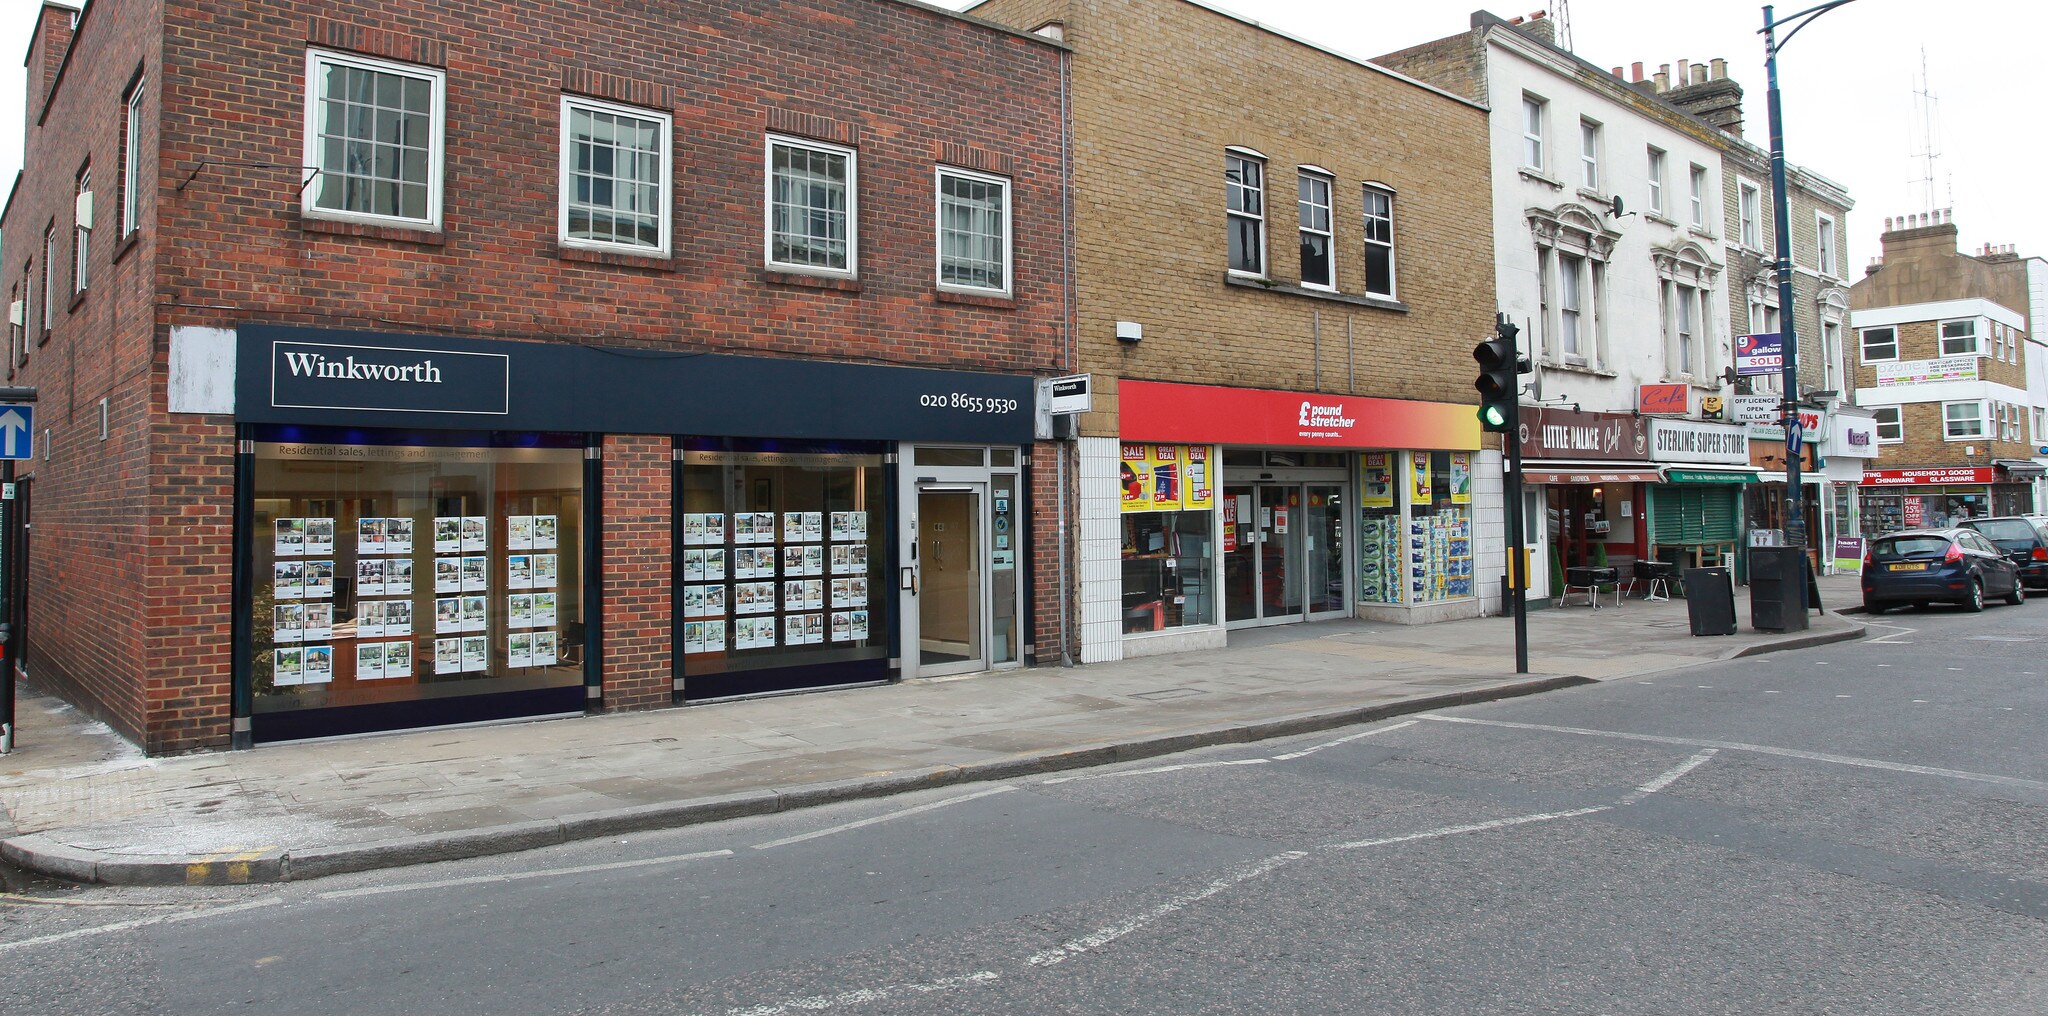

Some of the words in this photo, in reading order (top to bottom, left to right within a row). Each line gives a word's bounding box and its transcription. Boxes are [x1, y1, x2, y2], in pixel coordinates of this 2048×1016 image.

[1751, 346, 1781, 355] gallow
[284, 351, 442, 383] Winkworth
[1750, 357, 1782, 366] SOLD
[1054, 383, 1077, 391] Winkworth
[920, 394, 947, 407] 020
[951, 392, 983, 412] 8655
[986, 398, 1017, 413] 9530
[1311, 404, 1342, 417] pound
[1310, 415, 1356, 427] stretcher
[1543, 424, 1568, 449] LITTLE
[1570, 425, 1599, 450] PALACE
[1657, 429, 1695, 452] STERLING
[1697, 430, 1721, 453] SUPER
[1722, 432, 1745, 454] STORE
[1848, 428, 1870, 445] haart
[279, 445, 336, 456] Residential
[339, 446, 366, 457] sales,
[368, 447, 405, 460] lettings
[408, 449, 426, 458] and
[428, 449, 490, 461] management
[1123, 446, 1144, 457] SALE
[1159, 452, 1175, 460] DEAL
[1190, 452, 1205, 460] DEAL
[1904, 505, 1920, 514] 25%
